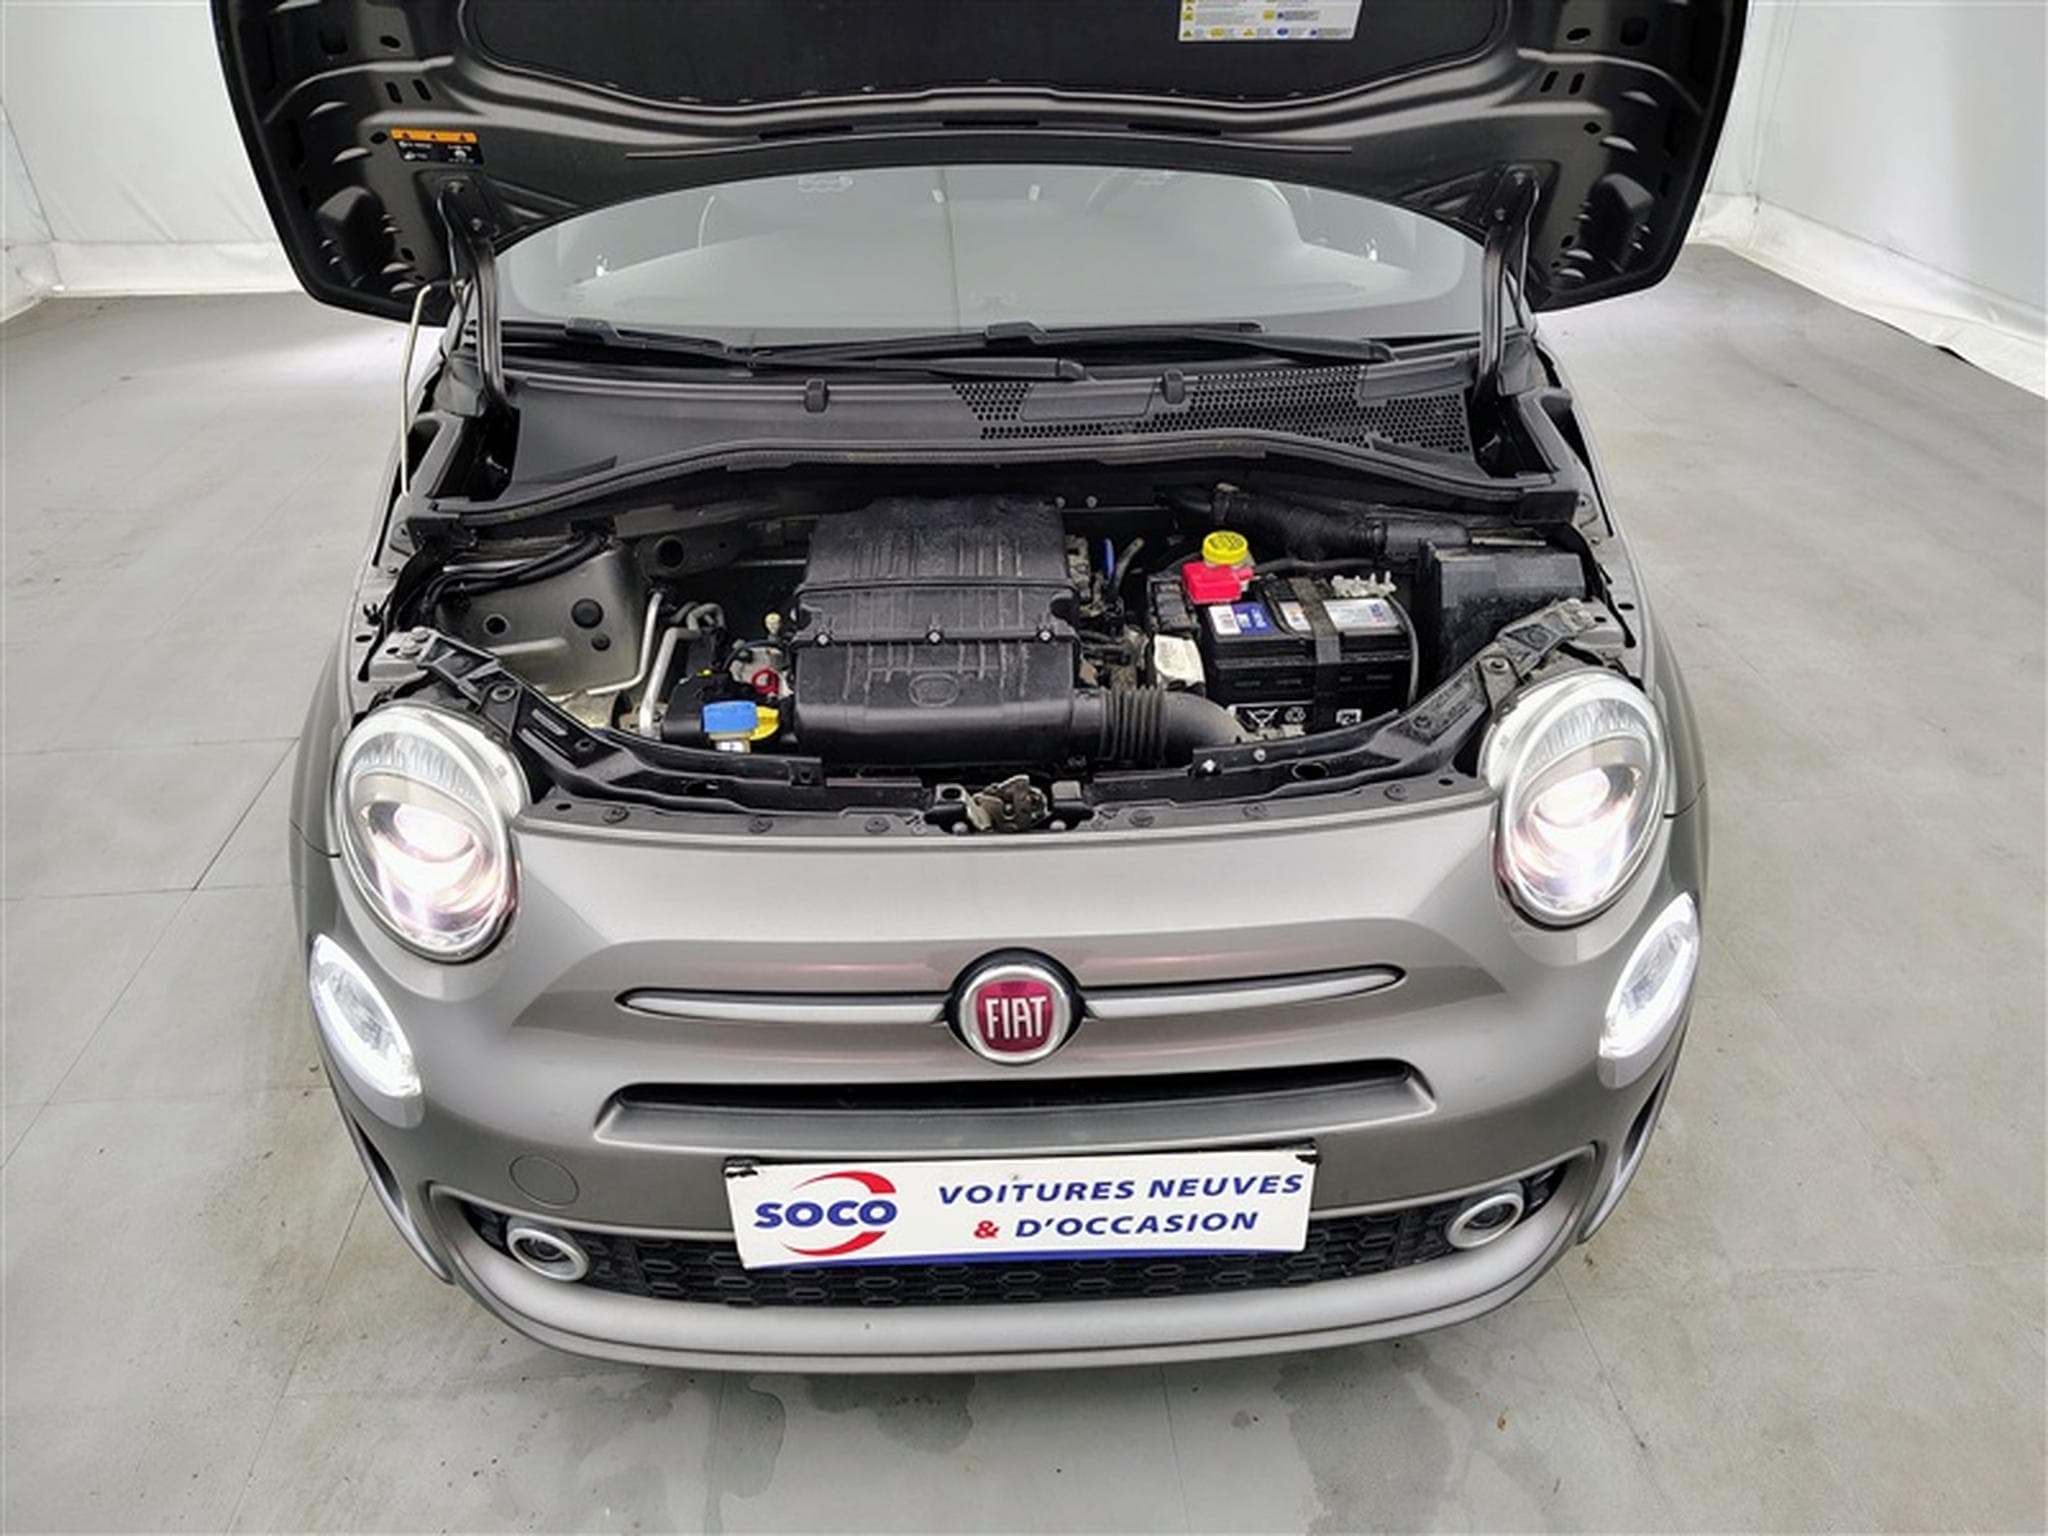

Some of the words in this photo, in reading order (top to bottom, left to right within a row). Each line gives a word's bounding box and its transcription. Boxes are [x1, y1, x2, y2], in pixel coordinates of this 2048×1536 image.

[984, 996, 1047, 1039] FIAT
[939, 1180, 1134, 1204] VOITURES
[1147, 1174, 1304, 1199] NEUVES
[754, 1199, 898, 1228] SOCO
[974, 1220, 999, 1239] &
[1015, 1211, 1258, 1238] D'OCCASION
